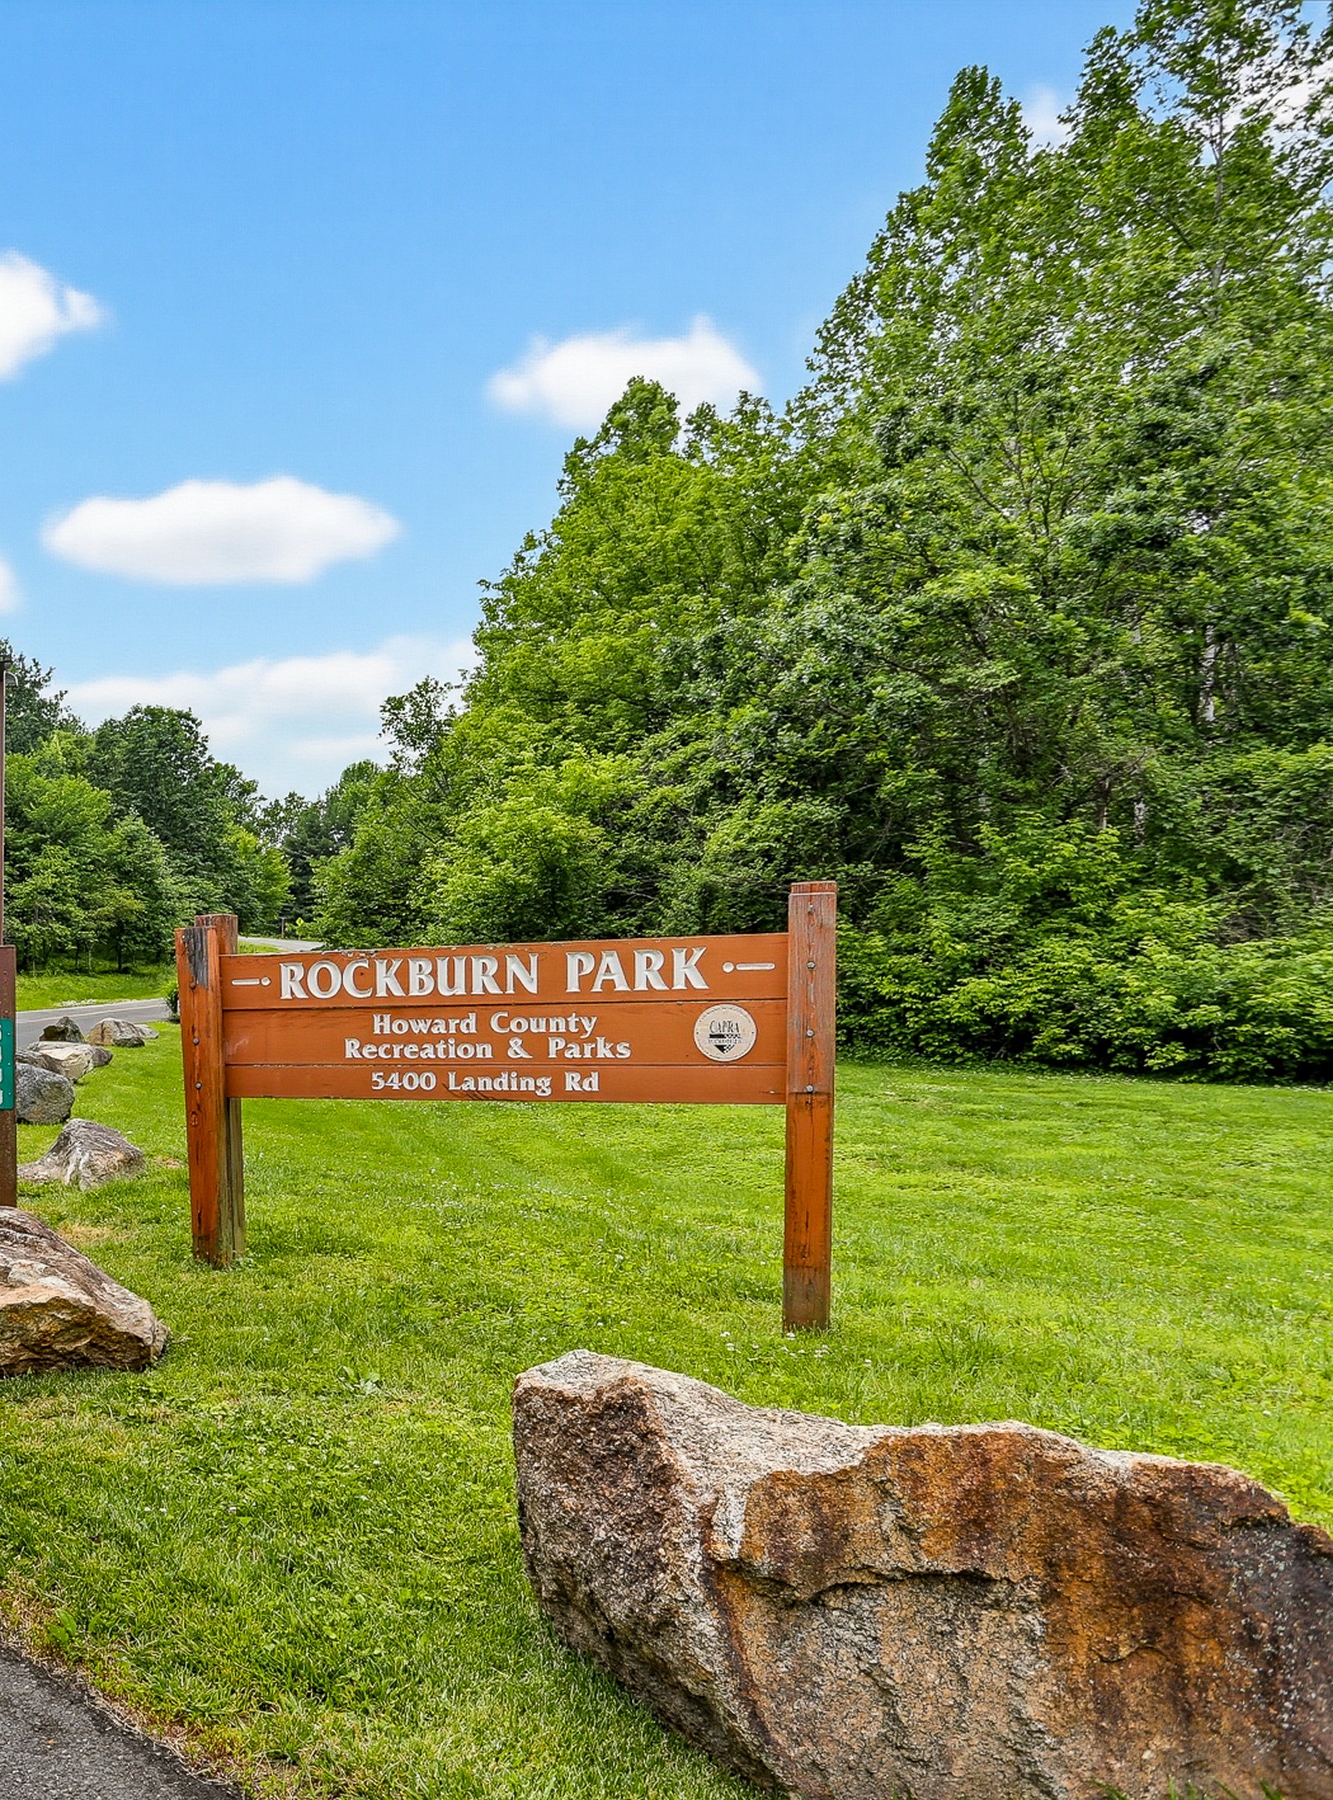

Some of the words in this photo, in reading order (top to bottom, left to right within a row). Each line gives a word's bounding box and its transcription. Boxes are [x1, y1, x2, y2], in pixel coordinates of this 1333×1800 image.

[279, 953, 539, 999] ROCKBURN
[565, 946, 709, 993] PARK
[372, 1013, 476, 1035] Howard
[490, 1012, 597, 1038] County
[344, 1038, 493, 1059] Recreation
[507, 1038, 533, 1059] &
[548, 1036, 631, 1059] Parks
[371, 1071, 437, 1092] 5400
[448, 1071, 552, 1097] Landing
[564, 1071, 599, 1092] Rd
